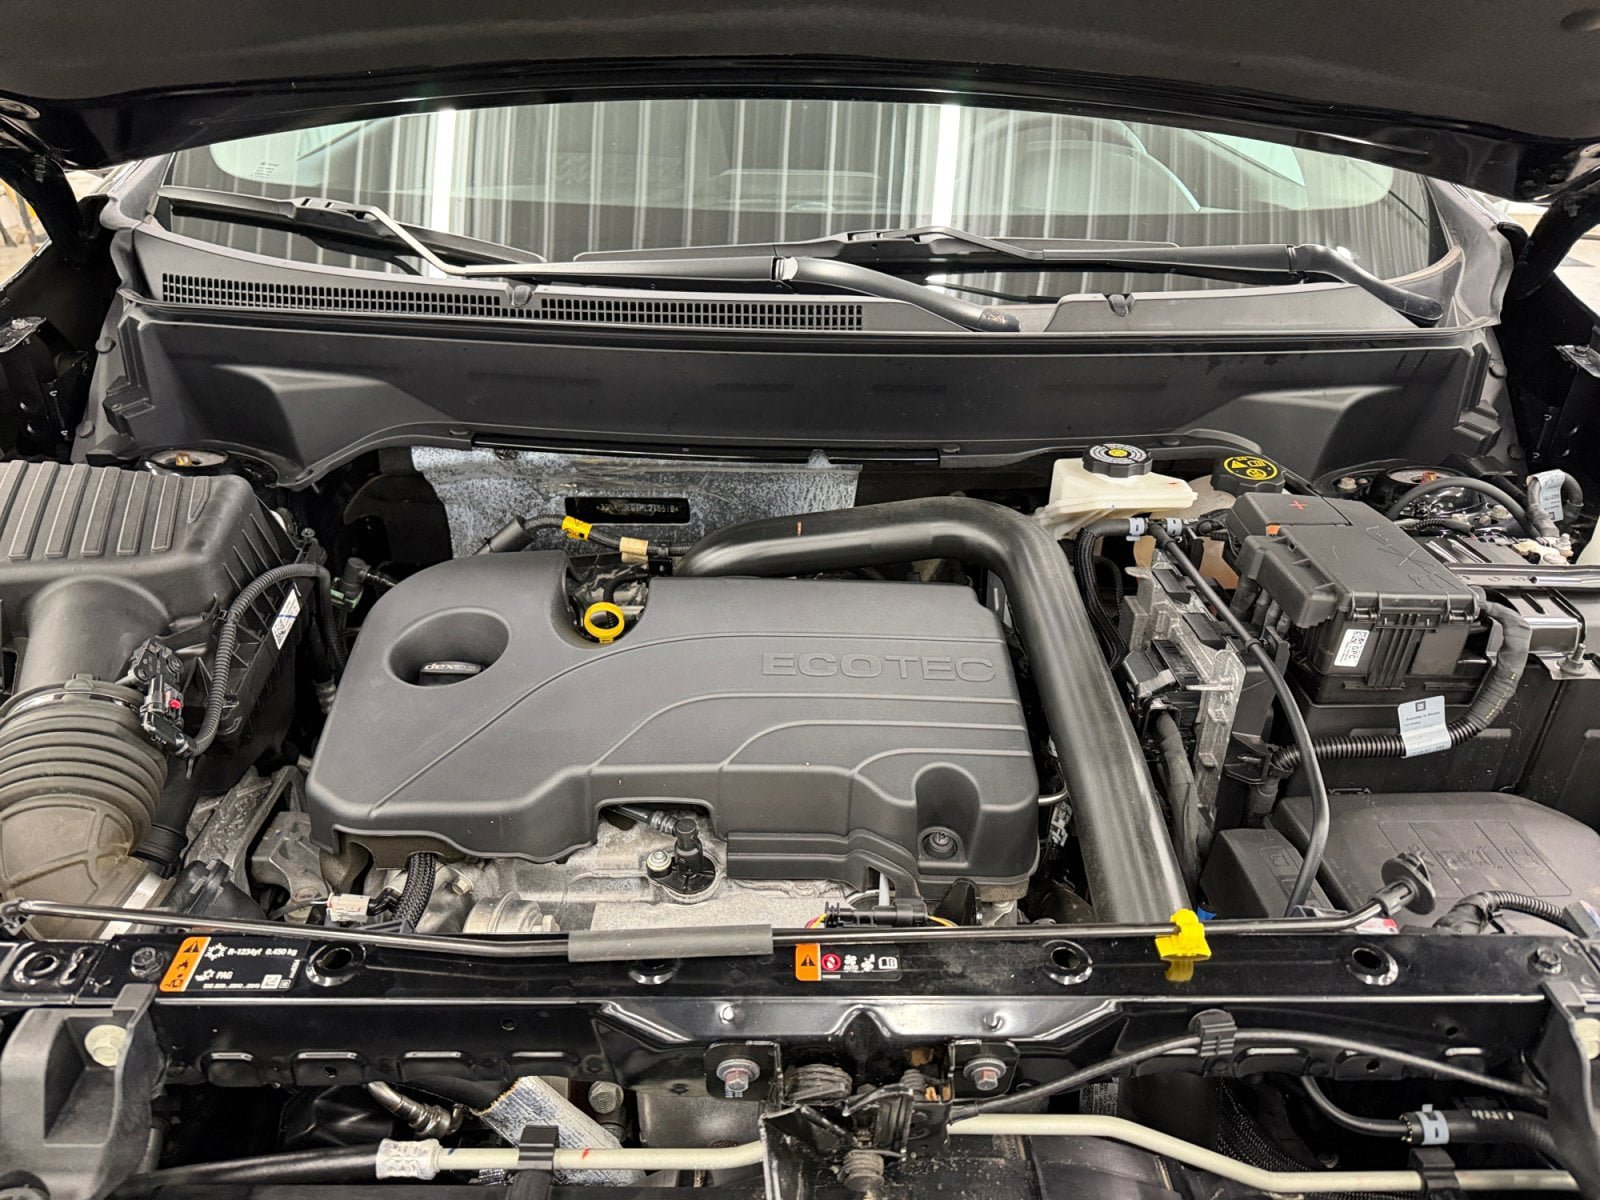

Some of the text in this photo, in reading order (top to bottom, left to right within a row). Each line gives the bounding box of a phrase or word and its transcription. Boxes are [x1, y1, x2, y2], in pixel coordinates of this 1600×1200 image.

[762, 652, 996, 682] ECOTEC
[227, 948, 262, 956] R-1234yf
[287, 948, 298, 957] kg
[215, 971, 234, 980] PAG
